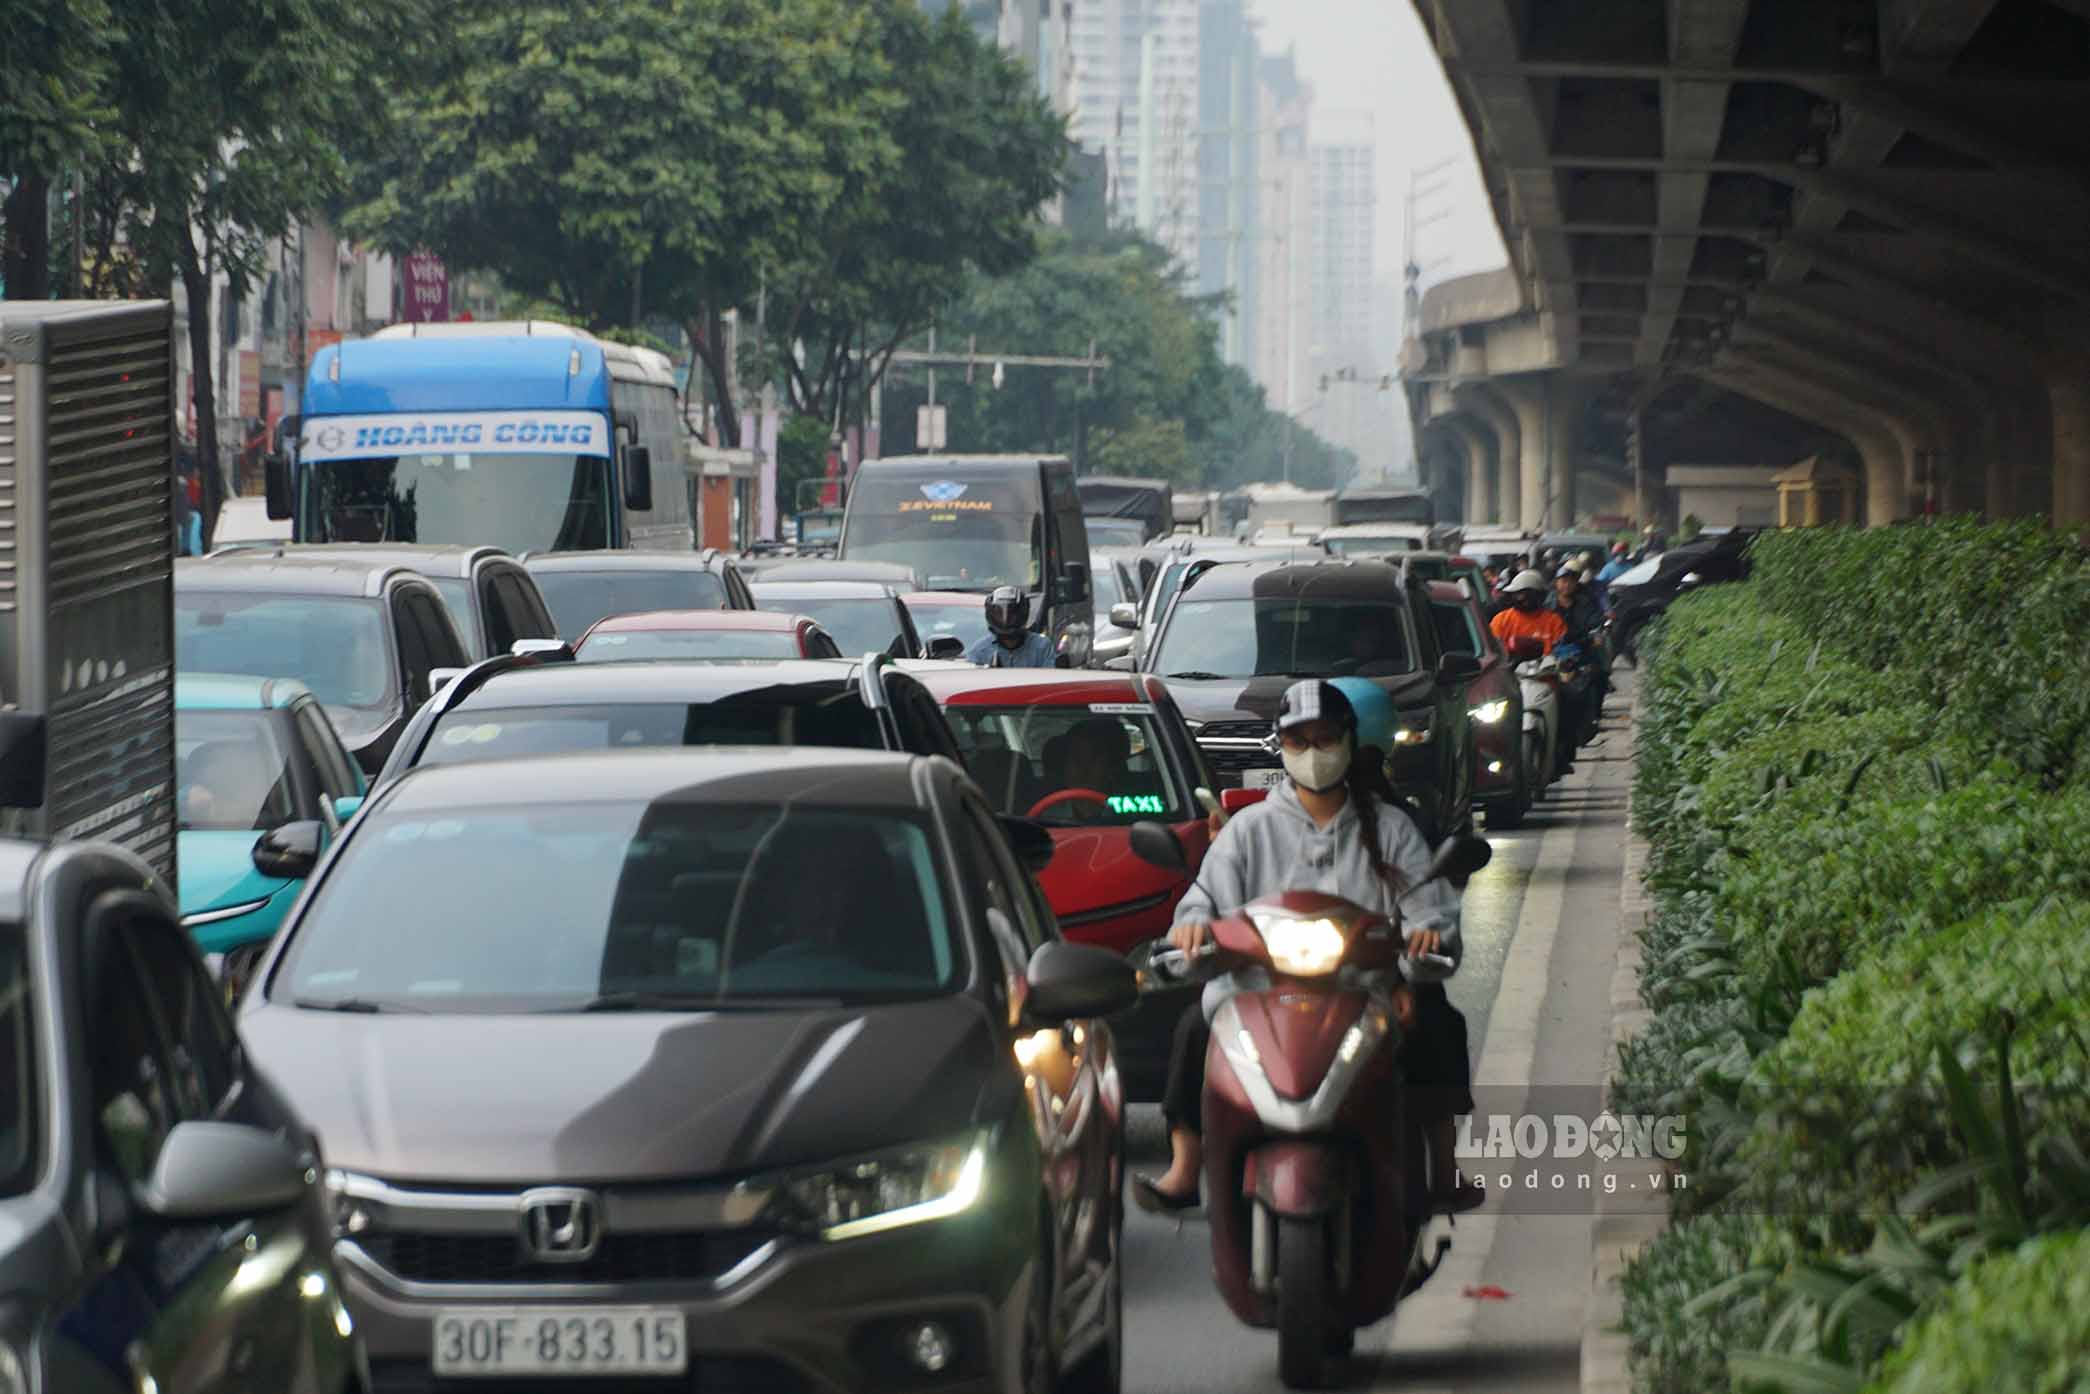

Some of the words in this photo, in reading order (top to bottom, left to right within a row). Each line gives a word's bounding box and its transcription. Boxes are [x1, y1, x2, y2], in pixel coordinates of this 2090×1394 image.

[494, 419, 592, 445] CÔNG
[1107, 795, 1163, 813] TAXI
[442, 1317, 678, 1362] 30F-833.15
